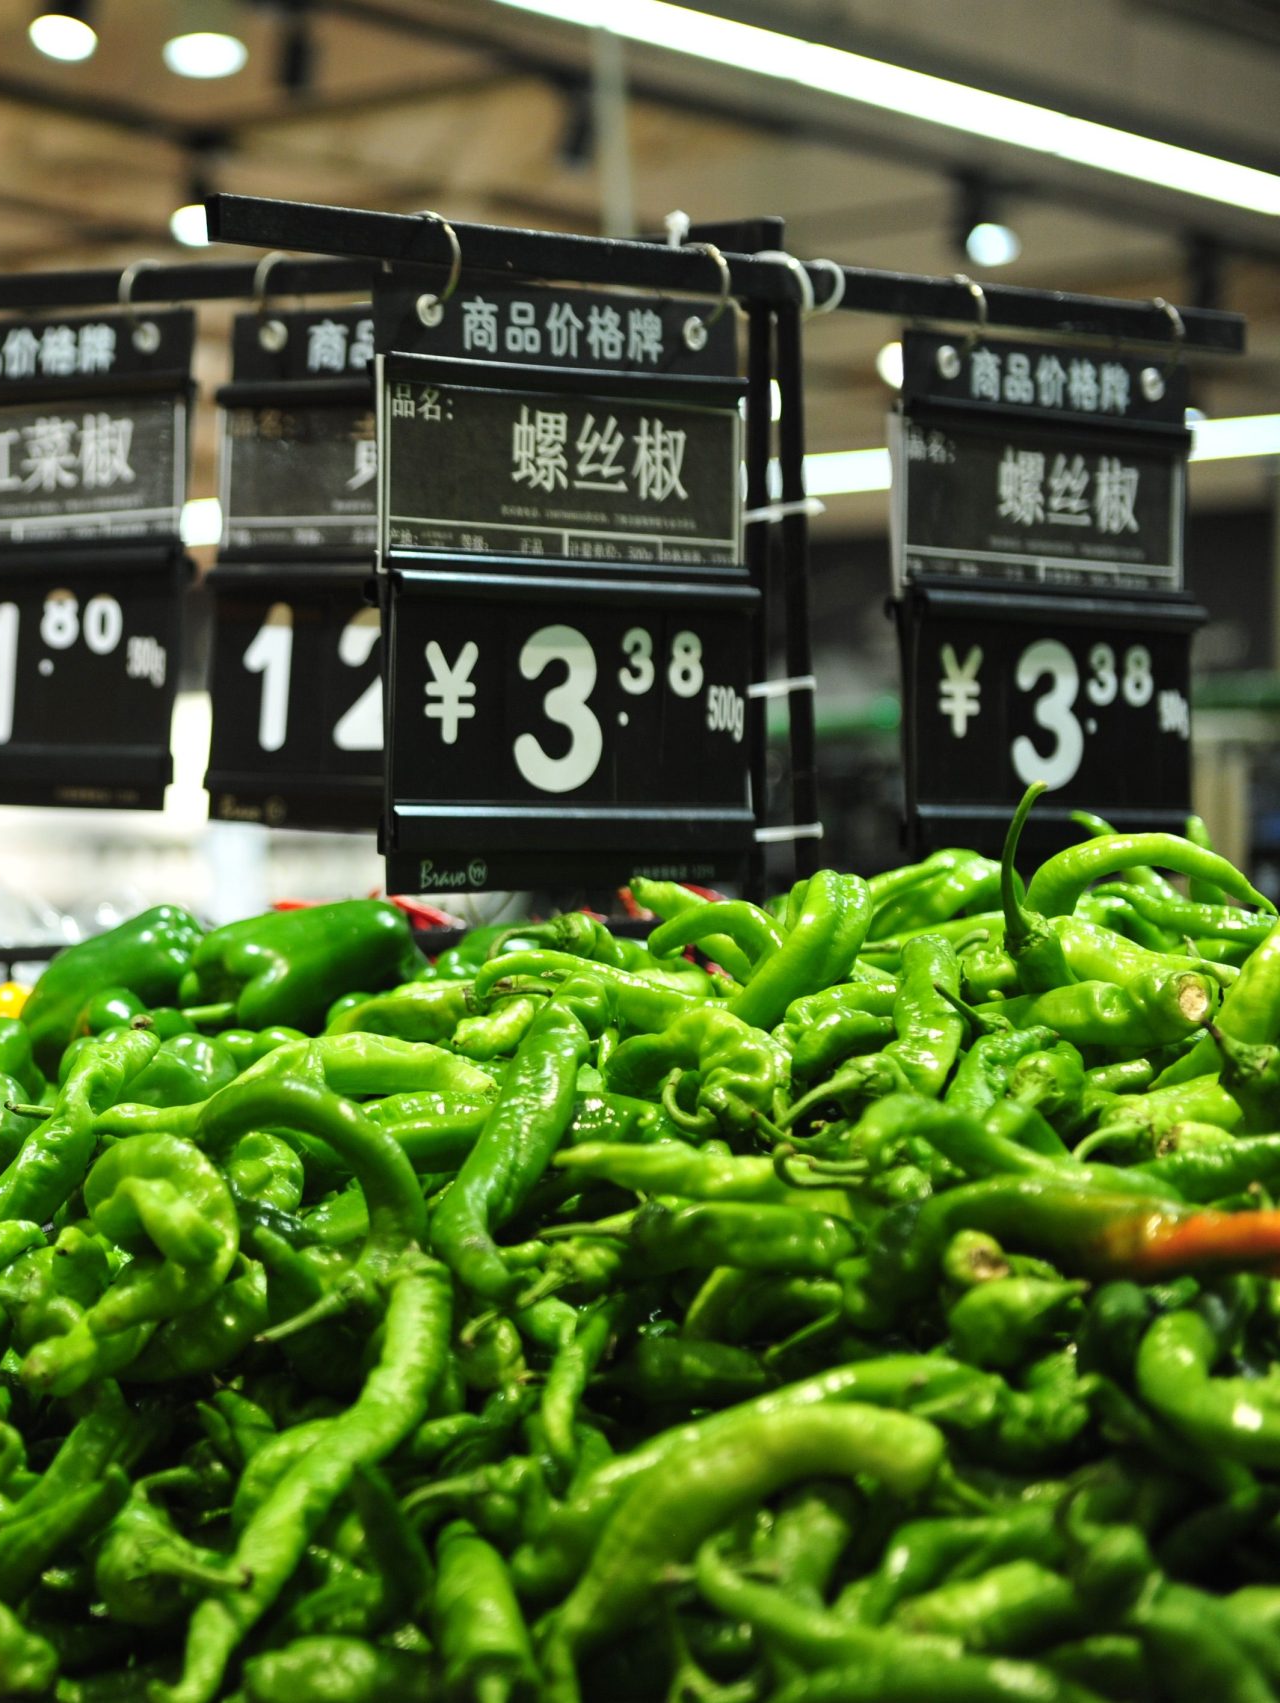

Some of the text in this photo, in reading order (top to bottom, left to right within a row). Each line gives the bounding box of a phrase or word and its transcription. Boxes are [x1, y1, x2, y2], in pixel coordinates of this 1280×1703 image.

[461, 295, 665, 364] 商品价格牌
[970, 347, 1130, 413] 商品价格牌
[511, 404, 689, 502] 螺丝椒
[997, 448, 1140, 534] 螺丝椒
[706, 684, 745, 743] 500g
[420, 860, 466, 889] Bravo
